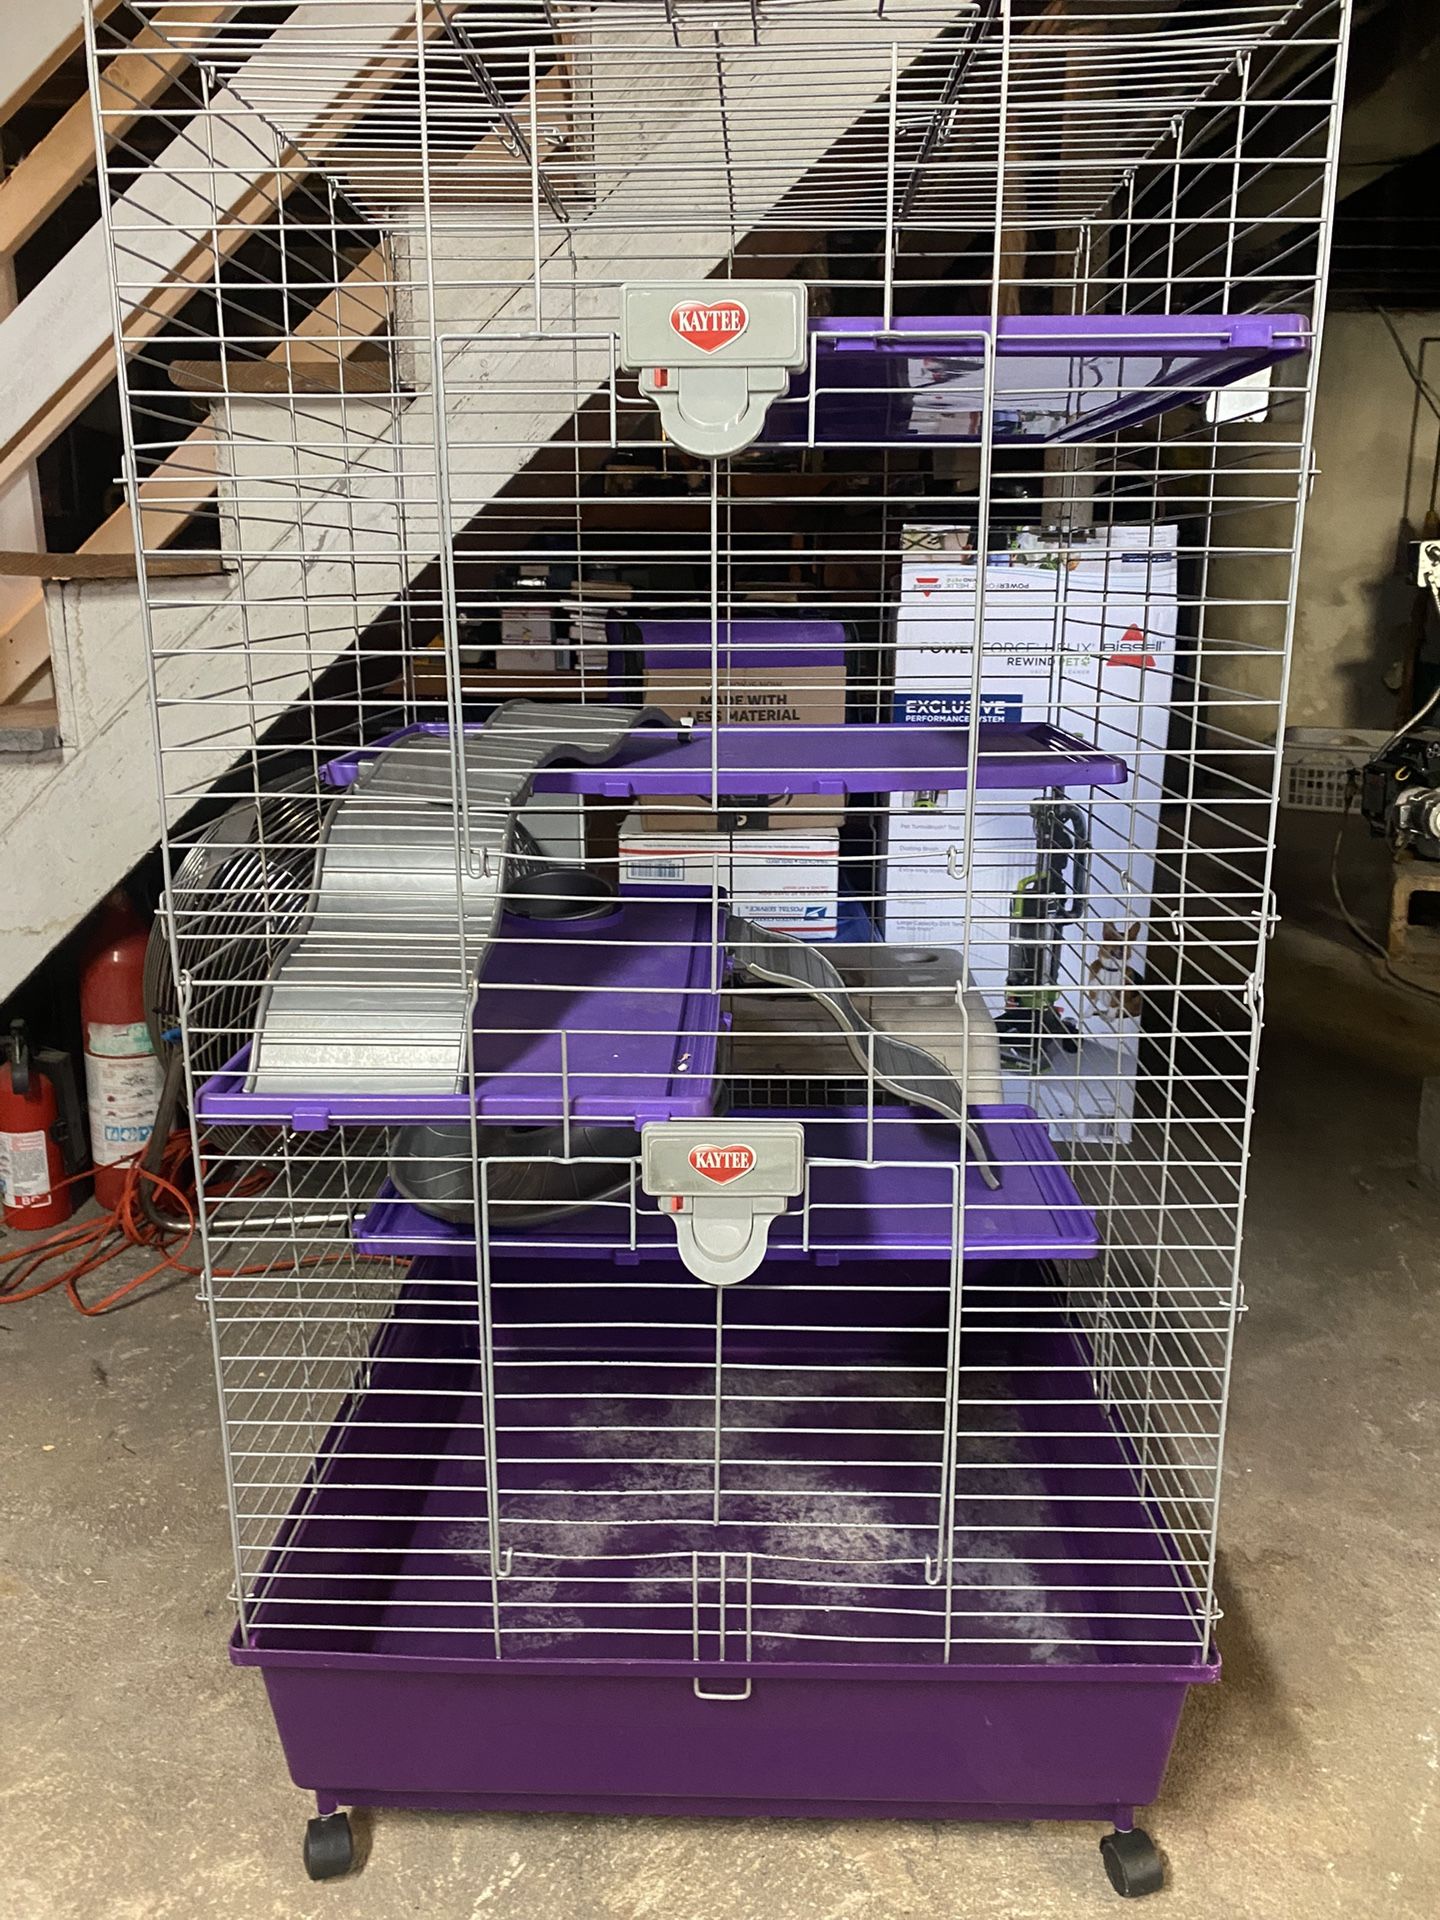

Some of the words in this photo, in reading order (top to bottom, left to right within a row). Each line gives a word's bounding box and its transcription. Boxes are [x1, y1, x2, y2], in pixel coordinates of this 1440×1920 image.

[678, 310, 741, 332] KAYTEE
[1007, 657, 1055, 666] REWIND
[700, 694, 743, 705] MADE
[747, 694, 787, 705] WITH
[906, 700, 1005, 714] EXCLUSVE
[729, 709, 800, 721] MATERIAL
[696, 1152, 750, 1169] KAYTEE
